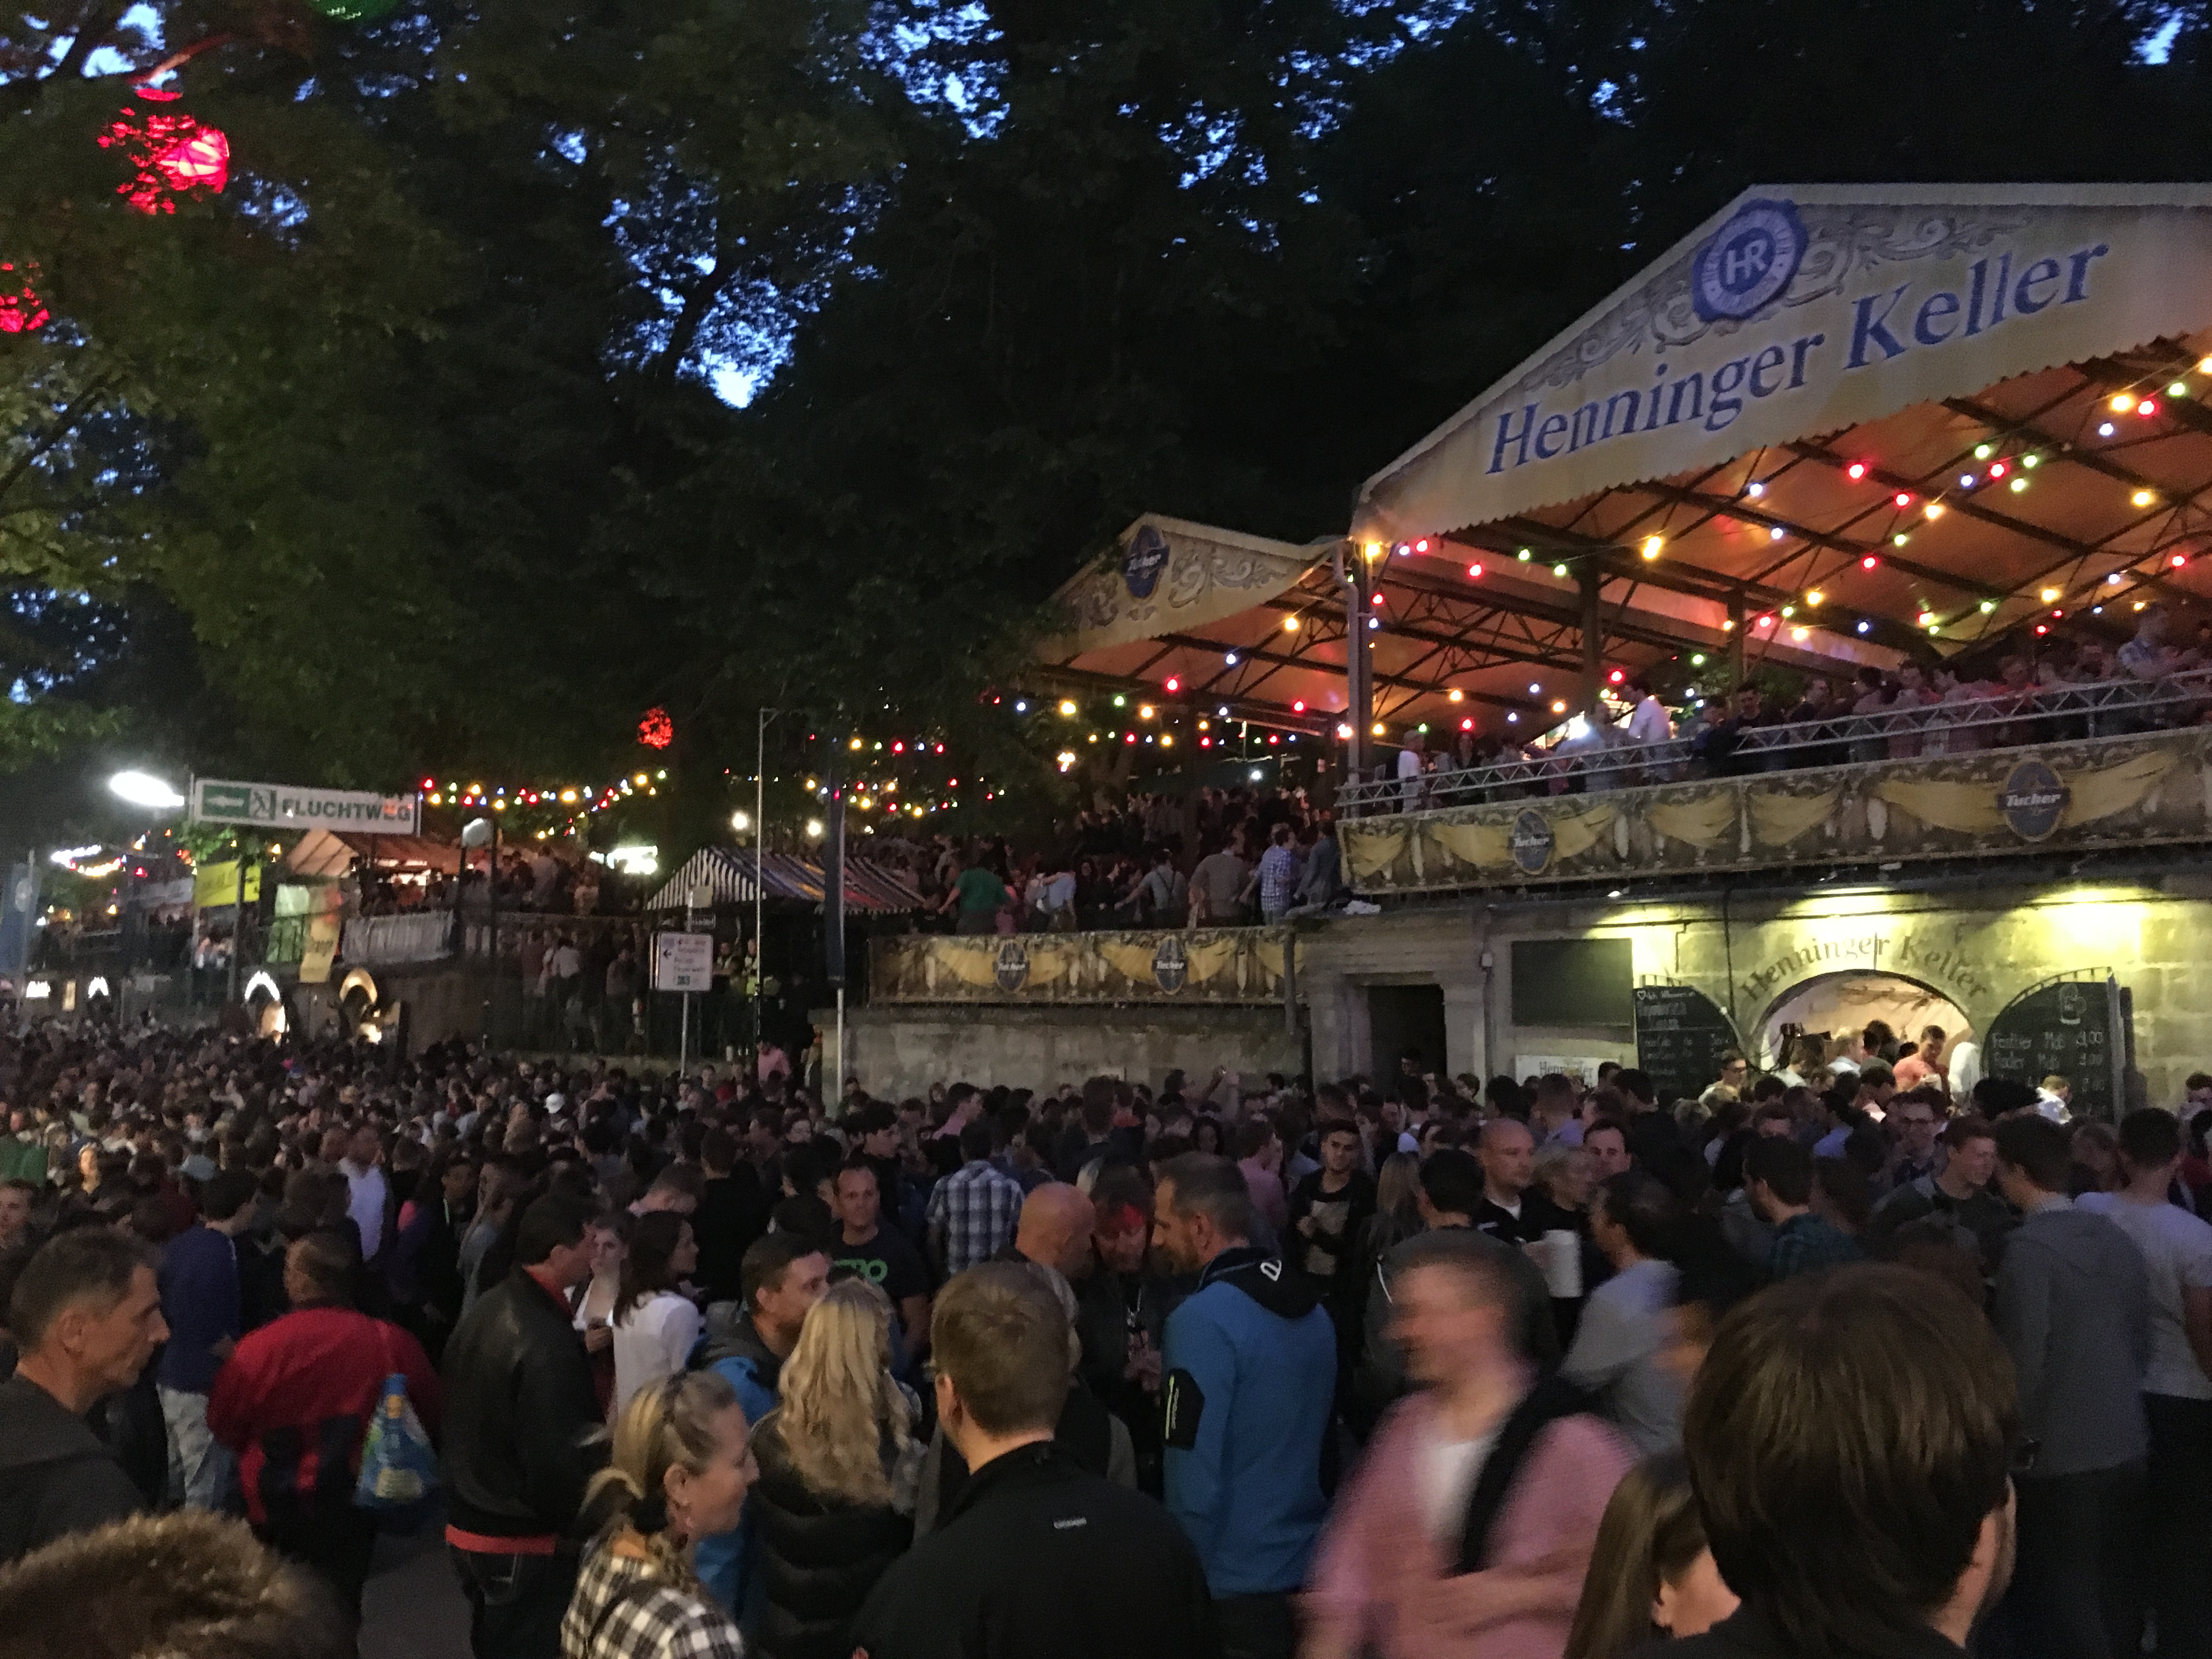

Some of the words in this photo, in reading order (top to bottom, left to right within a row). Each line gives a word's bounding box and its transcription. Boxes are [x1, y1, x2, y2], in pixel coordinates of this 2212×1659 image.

[1486, 332, 1826, 475] Henninger
[1843, 243, 2109, 370] Keller
[2006, 793, 2061, 807] Tucher
[1741, 936, 1890, 1001] Henninger
[1900, 935, 1987, 997] Keller
